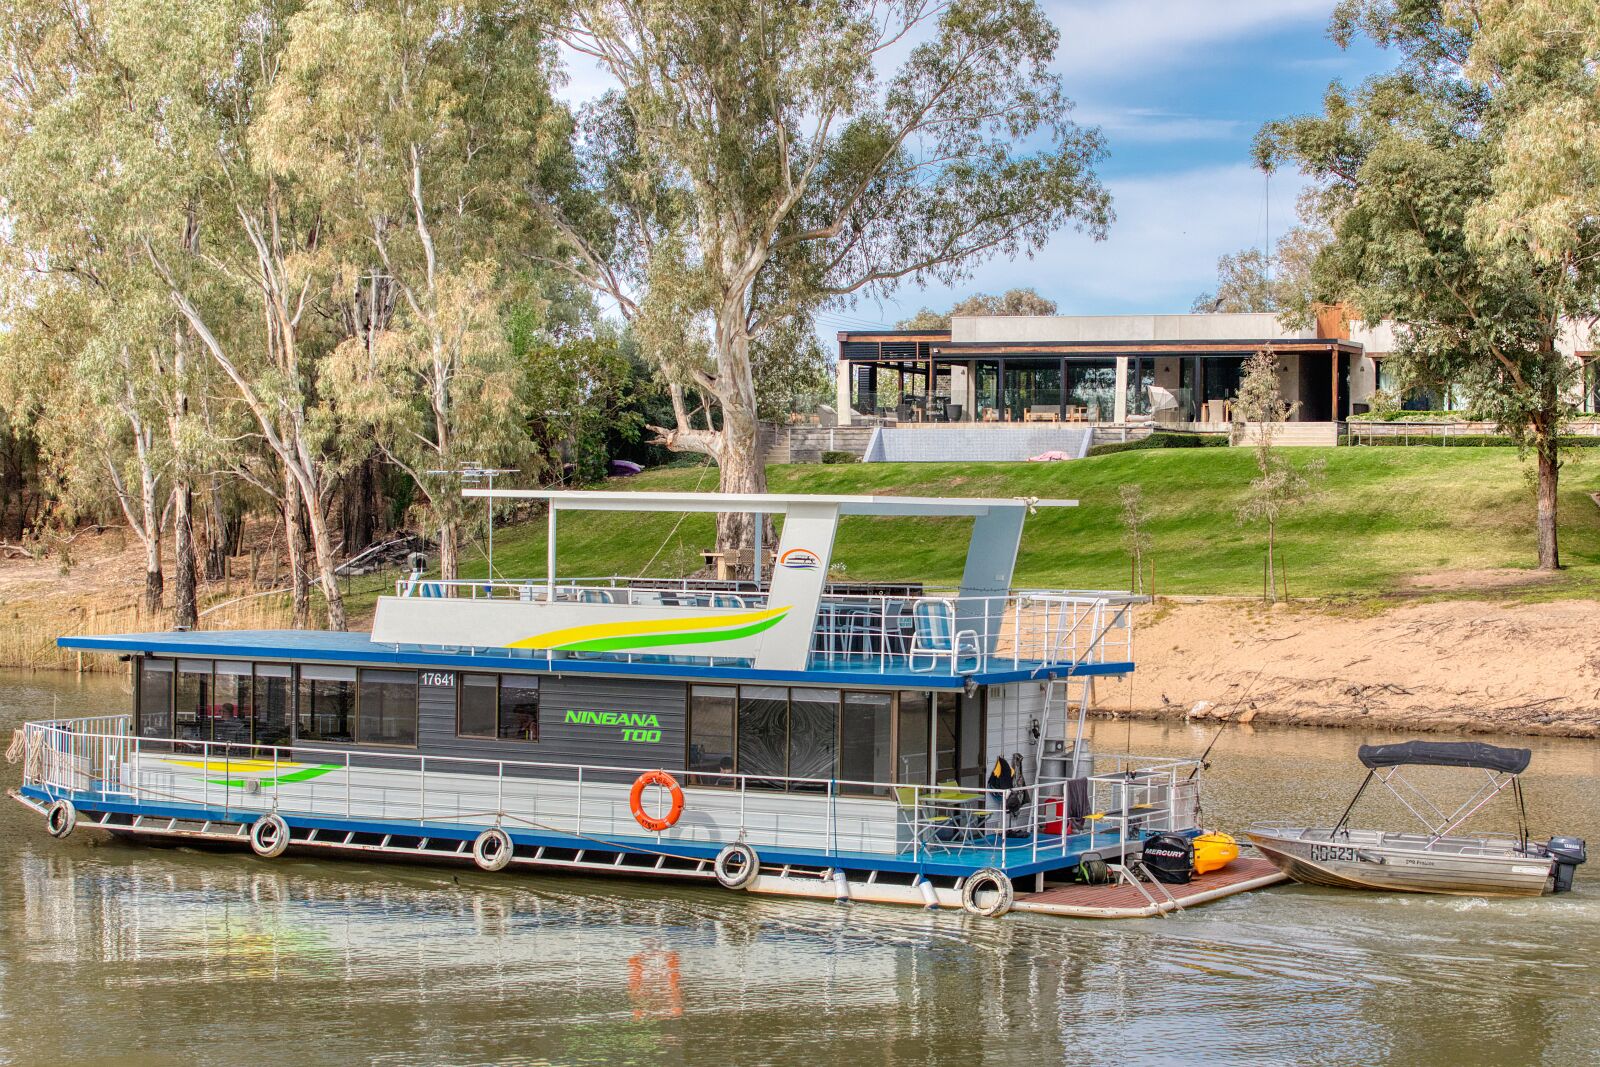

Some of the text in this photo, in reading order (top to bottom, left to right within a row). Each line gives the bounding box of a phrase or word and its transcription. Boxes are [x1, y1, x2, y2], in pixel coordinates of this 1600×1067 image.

[421, 672, 454, 686] 17641
[564, 710, 660, 727] NINGANA
[621, 728, 662, 743] TOO
[1144, 848, 1184, 858] MERCURY
